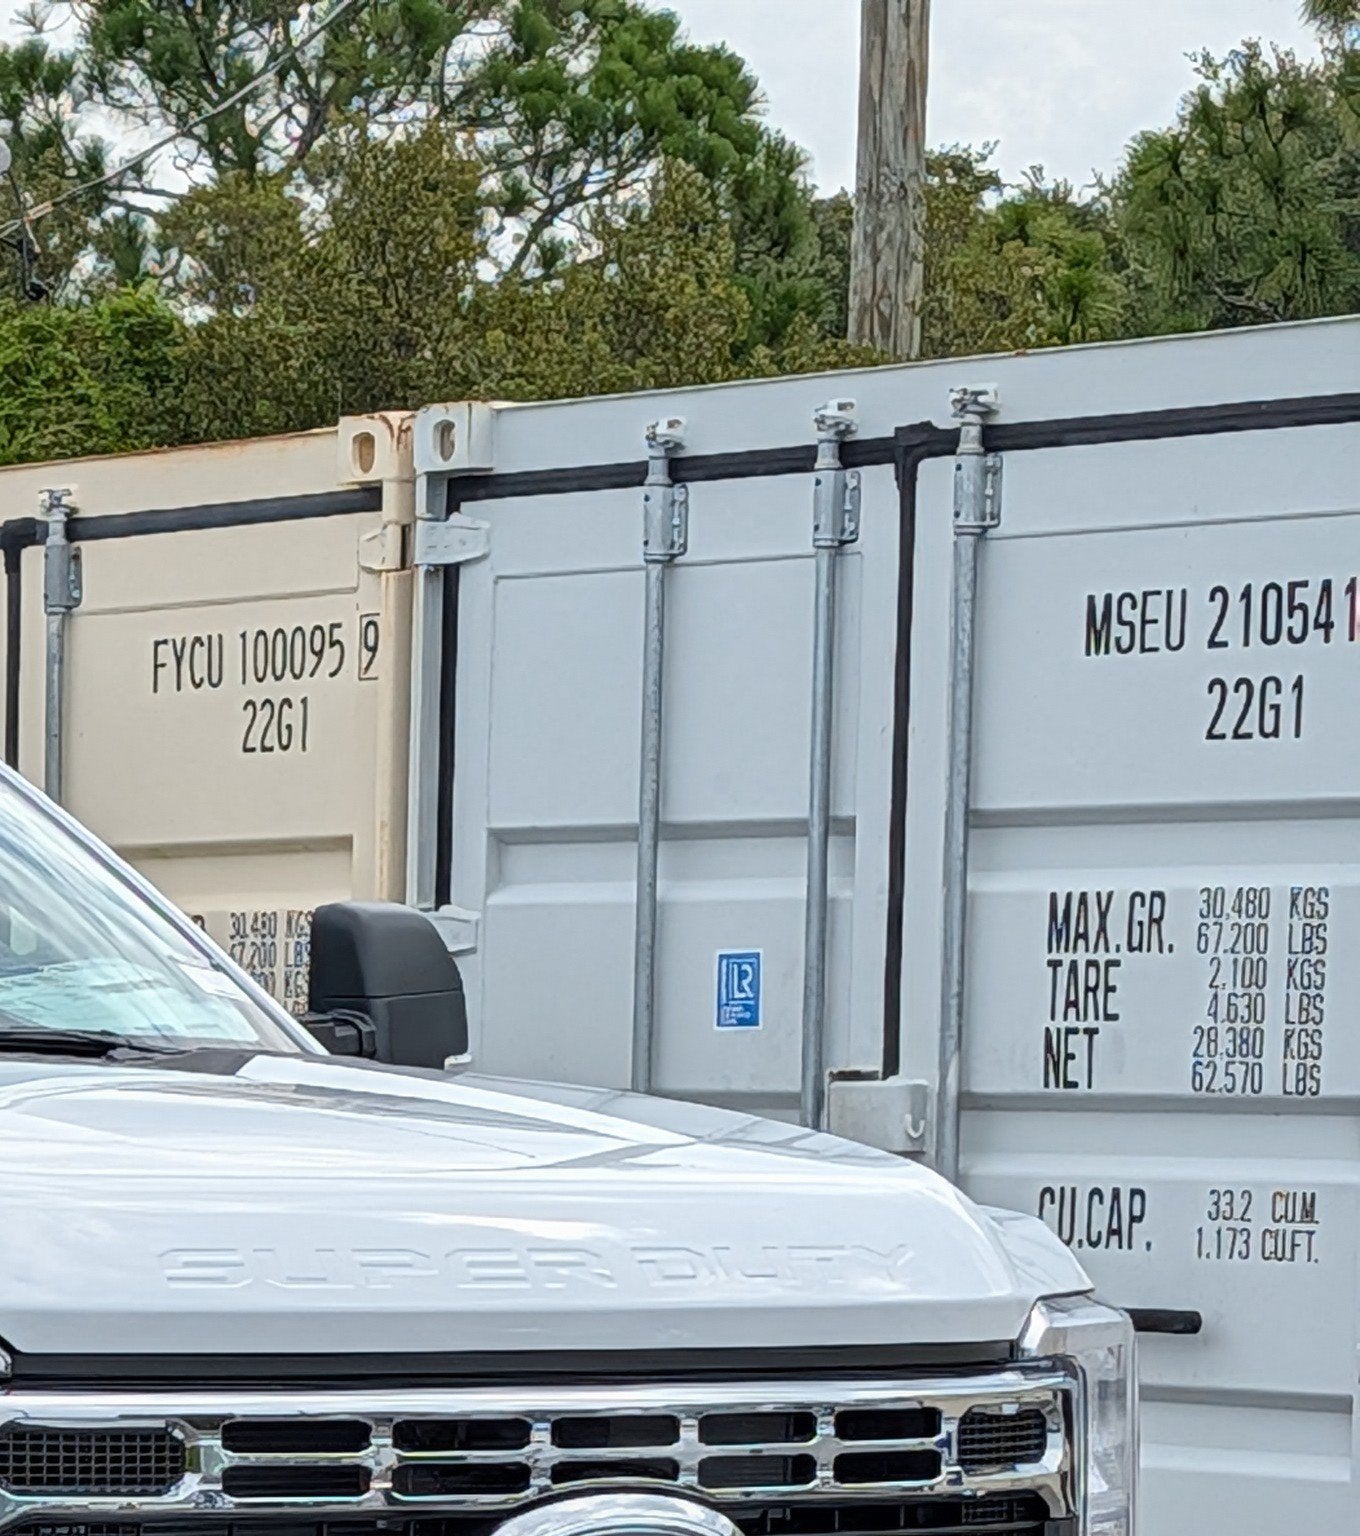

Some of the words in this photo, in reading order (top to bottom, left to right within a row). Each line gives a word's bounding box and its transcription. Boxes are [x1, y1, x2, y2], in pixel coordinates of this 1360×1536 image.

[1084, 588, 1187, 657] MSEU
[1207, 576, 1357, 649] 210541
[152, 633, 224, 693] FYCU
[239, 622, 346, 685] 100095
[362, 619, 380, 676] 9
[241, 696, 309, 753] 22G1
[1204, 674, 1304, 740] 22G1
[1047, 889, 1175, 955] MAX.GR.
[1289, 886, 1331, 920] KGS
[1287, 922, 1329, 955] LBS
[1046, 958, 1122, 1023] TARE
[1286, 956, 1327, 992] KGS
[1285, 992, 1326, 1026] LBS
[1043, 1026, 1101, 1091] NET
[1283, 1027, 1324, 1061] KGS
[1282, 1061, 1322, 1097] LBS
[157, 1246, 618, 1289] SUPER
[629, 1243, 916, 1290] DUTY
